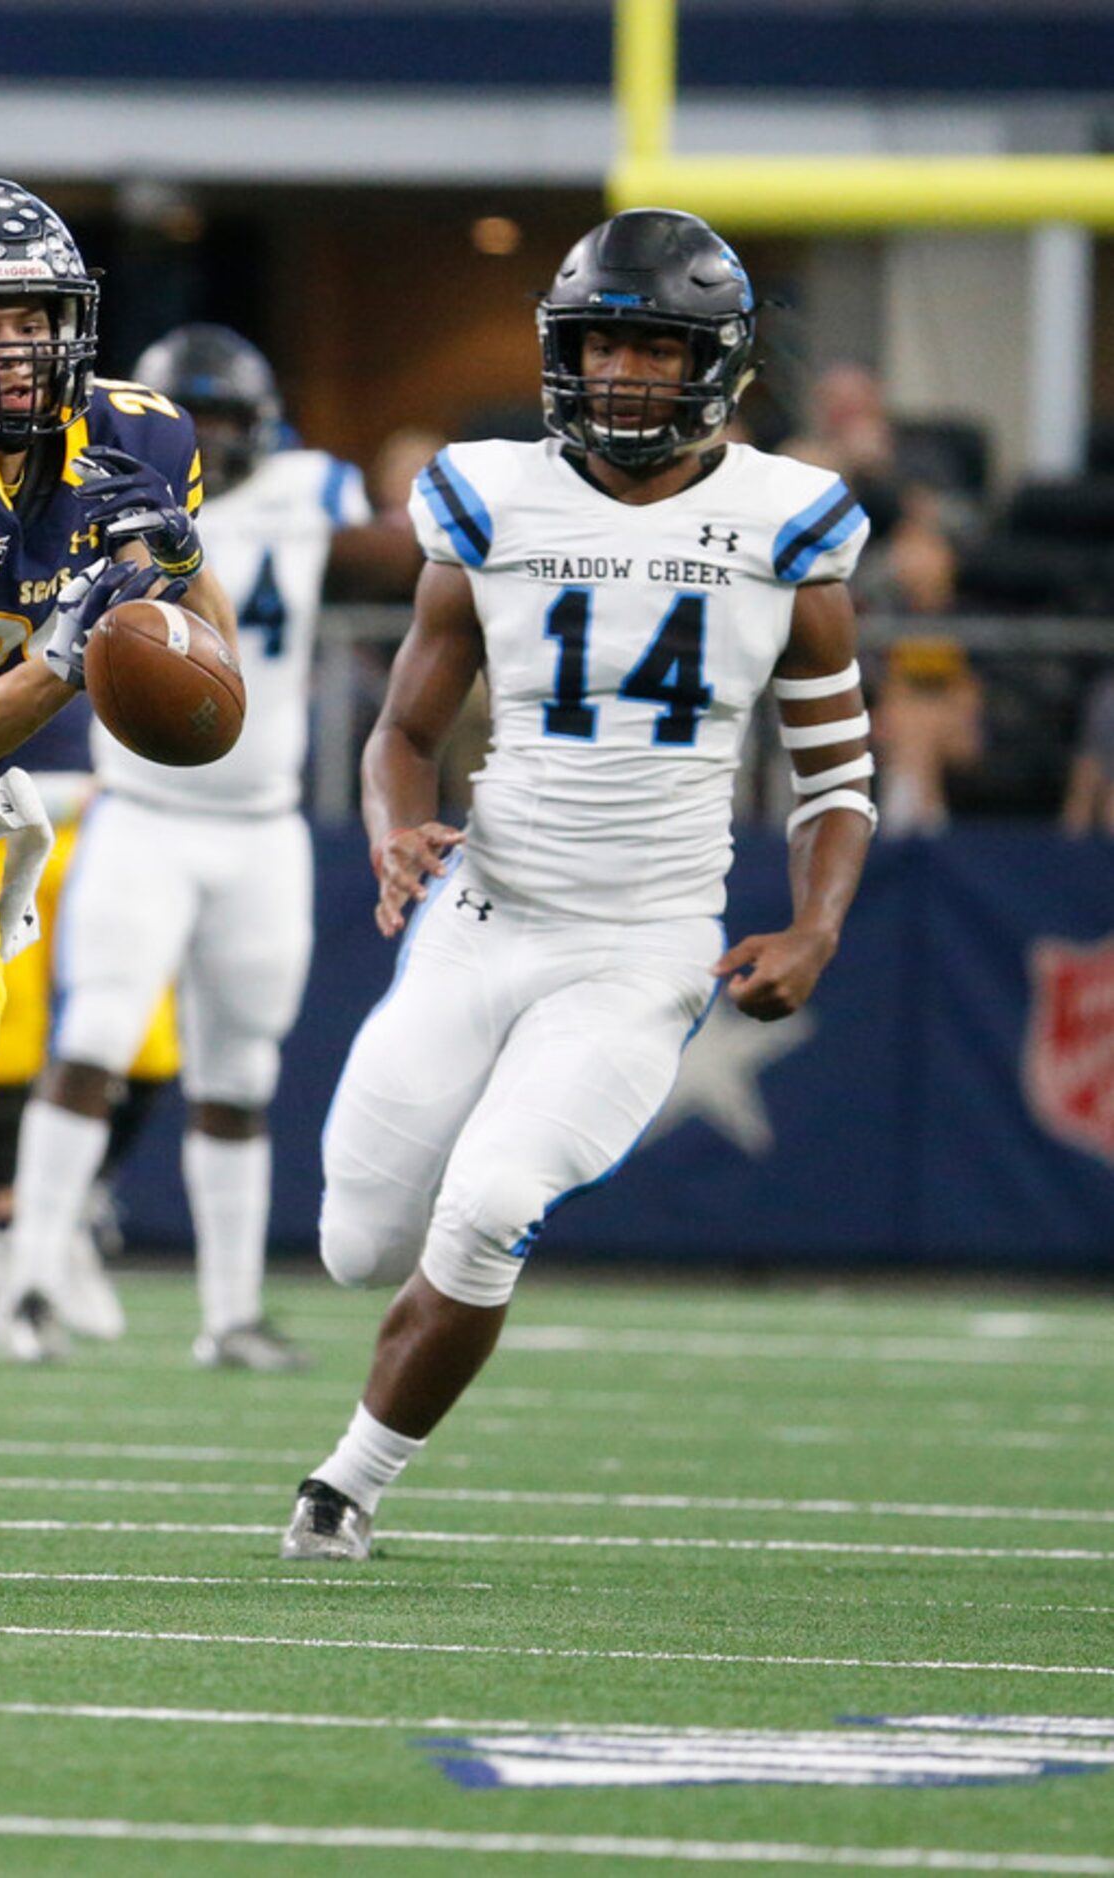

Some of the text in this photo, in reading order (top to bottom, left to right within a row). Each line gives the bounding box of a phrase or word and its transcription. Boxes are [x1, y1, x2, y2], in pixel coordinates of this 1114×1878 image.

[526, 558, 732, 586] SHADOW CREEK
[541, 584, 714, 747] 14
